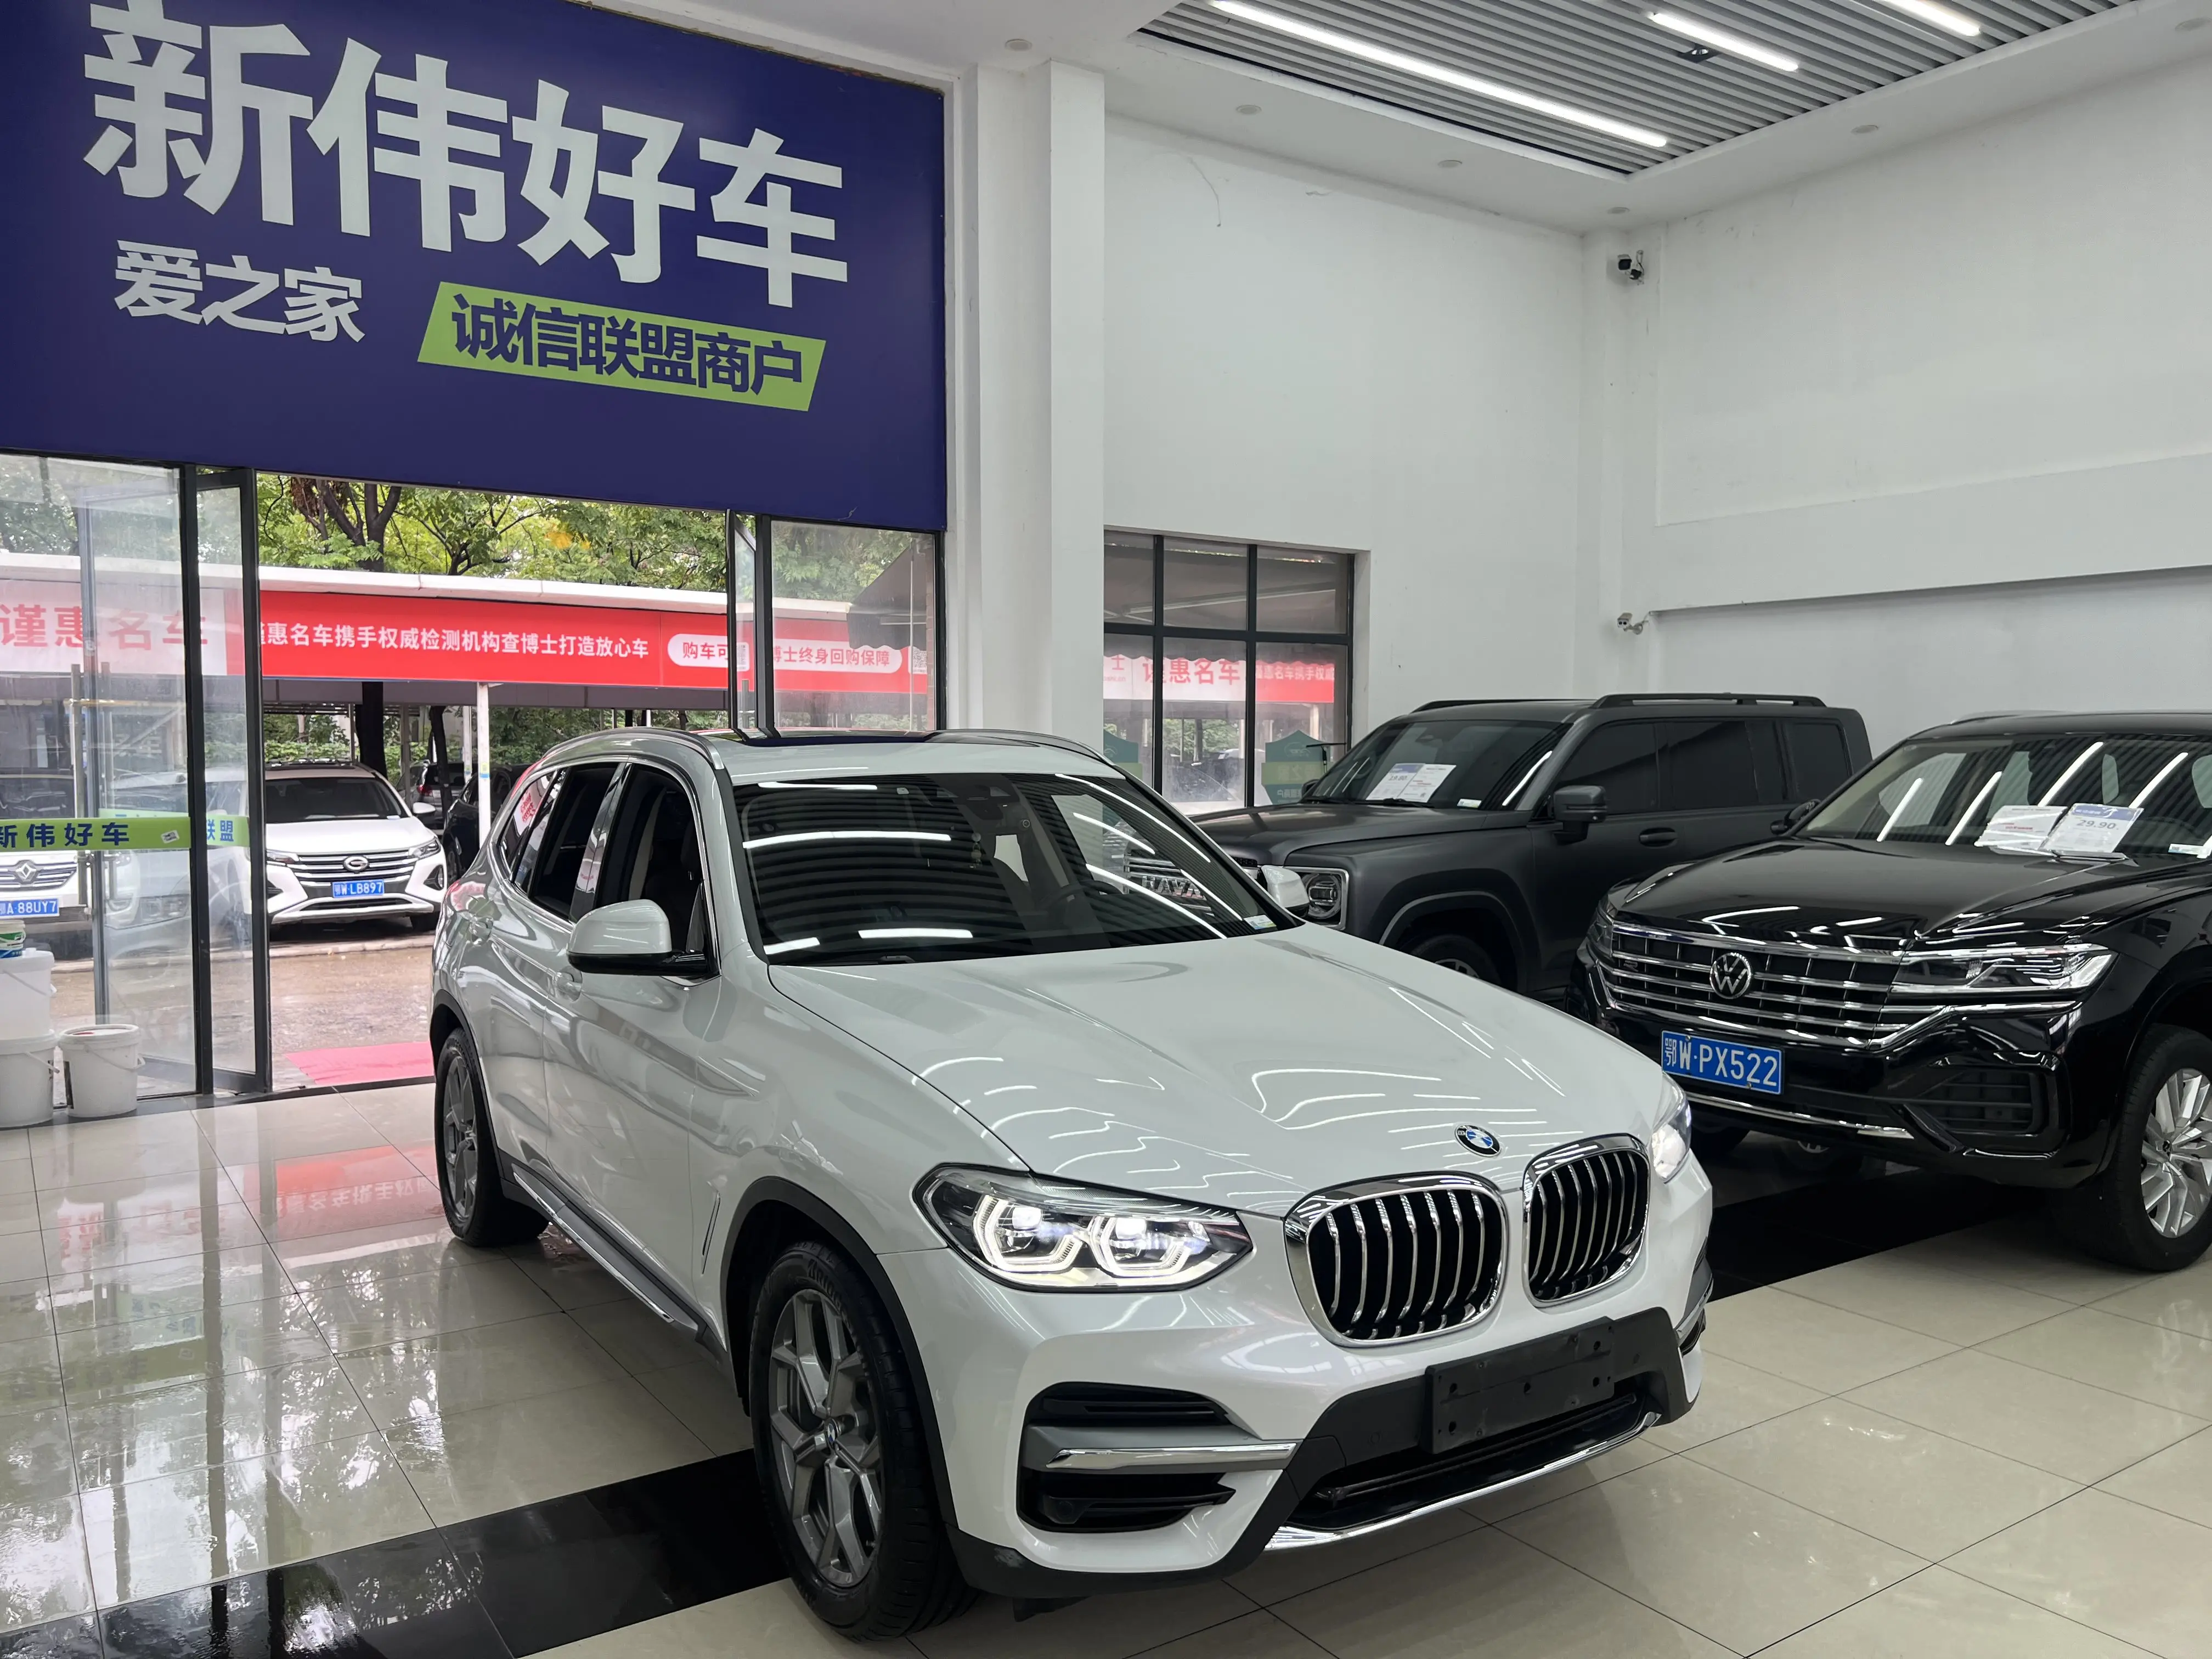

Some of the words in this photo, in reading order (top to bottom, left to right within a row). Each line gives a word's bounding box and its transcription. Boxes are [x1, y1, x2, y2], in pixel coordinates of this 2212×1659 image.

[83, 0, 848, 308] 新伟好车
[115, 240, 365, 343] 爱之家
[452, 294, 803, 396] 诚信联盟商户
[0, 822, 130, 849] 新伟好车
[1663, 1037, 1778, 1087] 鄂W·PX522
